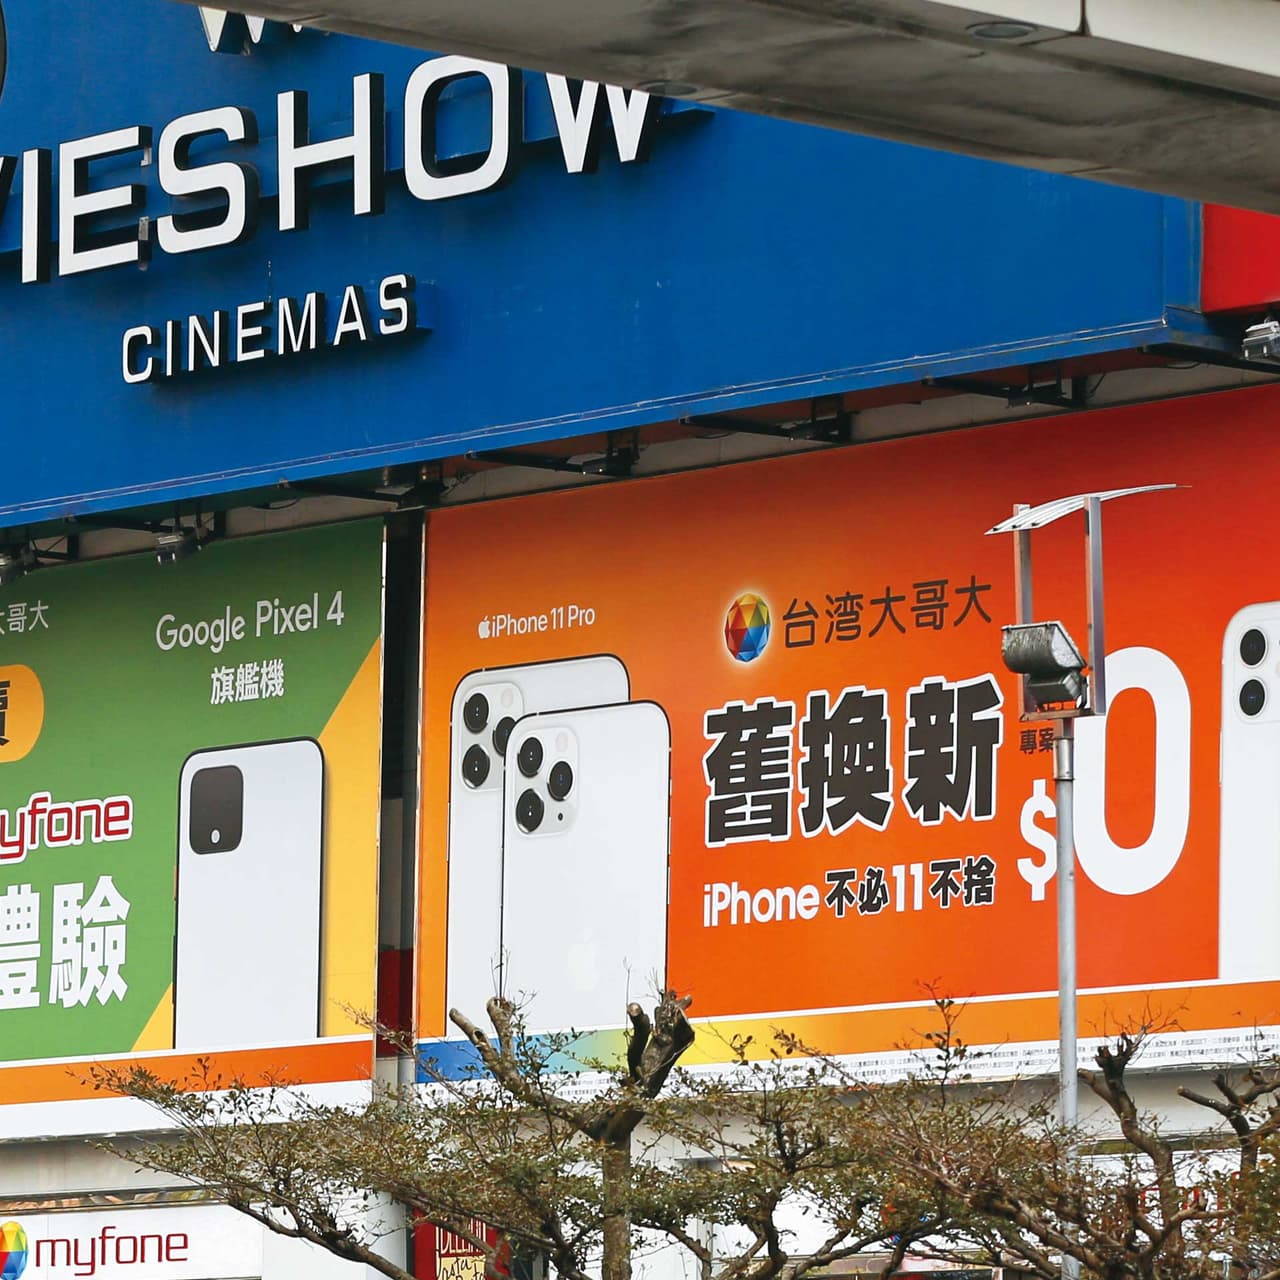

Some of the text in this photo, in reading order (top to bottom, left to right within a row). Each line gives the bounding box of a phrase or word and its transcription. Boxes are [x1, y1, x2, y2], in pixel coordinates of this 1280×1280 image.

[122, 273, 416, 385] CINEMAS
[155, 590, 346, 656] Google Pixel 4
[491, 604, 596, 638] iPhone 11 Pro
[209, 657, 286, 708] 旗艦機
[703, 673, 1004, 847] 舊換新
[1019, 727, 1055, 755] 專案
[34, 1226, 189, 1277] myfone
